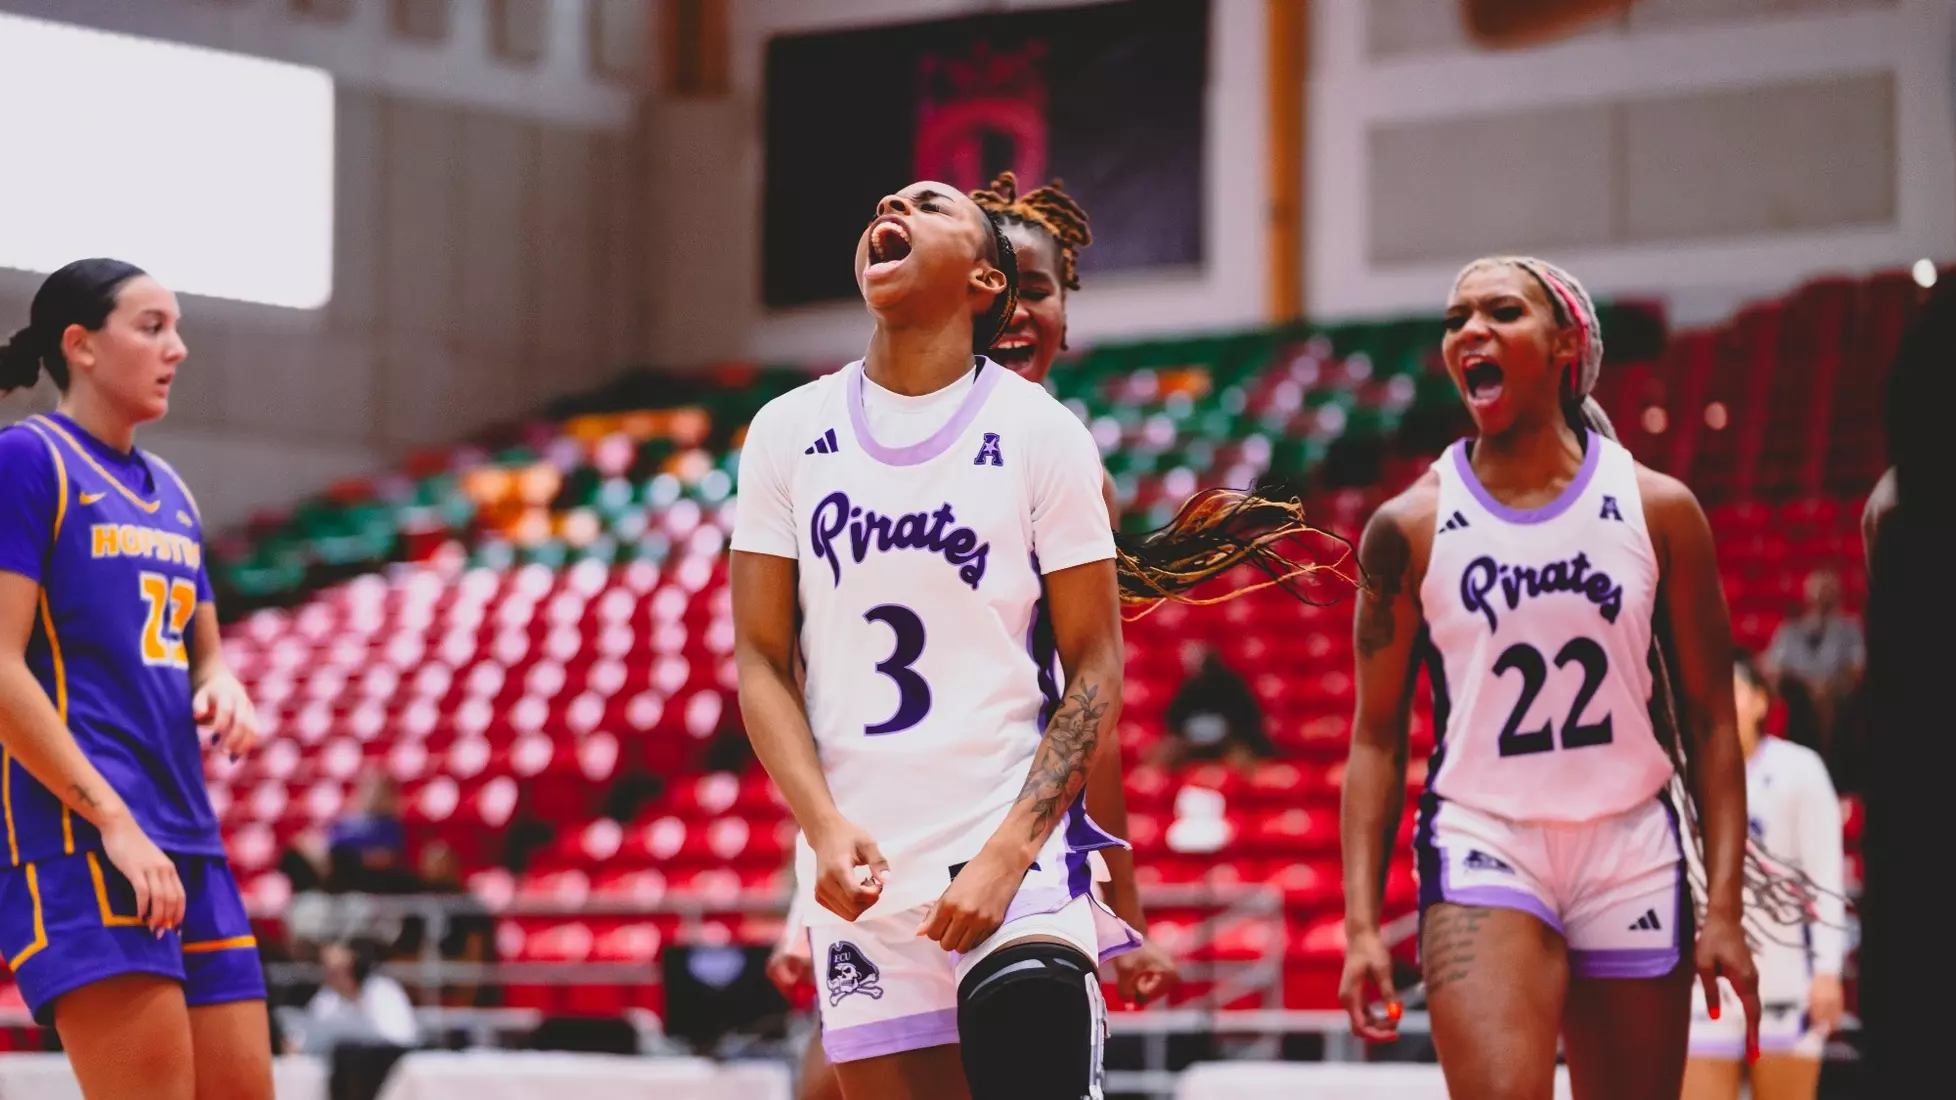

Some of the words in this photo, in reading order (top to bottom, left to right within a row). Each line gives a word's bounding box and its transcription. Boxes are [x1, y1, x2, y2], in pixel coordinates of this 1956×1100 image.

[91, 523, 200, 571] HOFSTR
[810, 490, 990, 590] Pirates
[1460, 551, 1623, 635] Pirates
[861, 602, 933, 736] 3
[1491, 636, 1613, 758] 22
[834, 951, 851, 963] ECU
